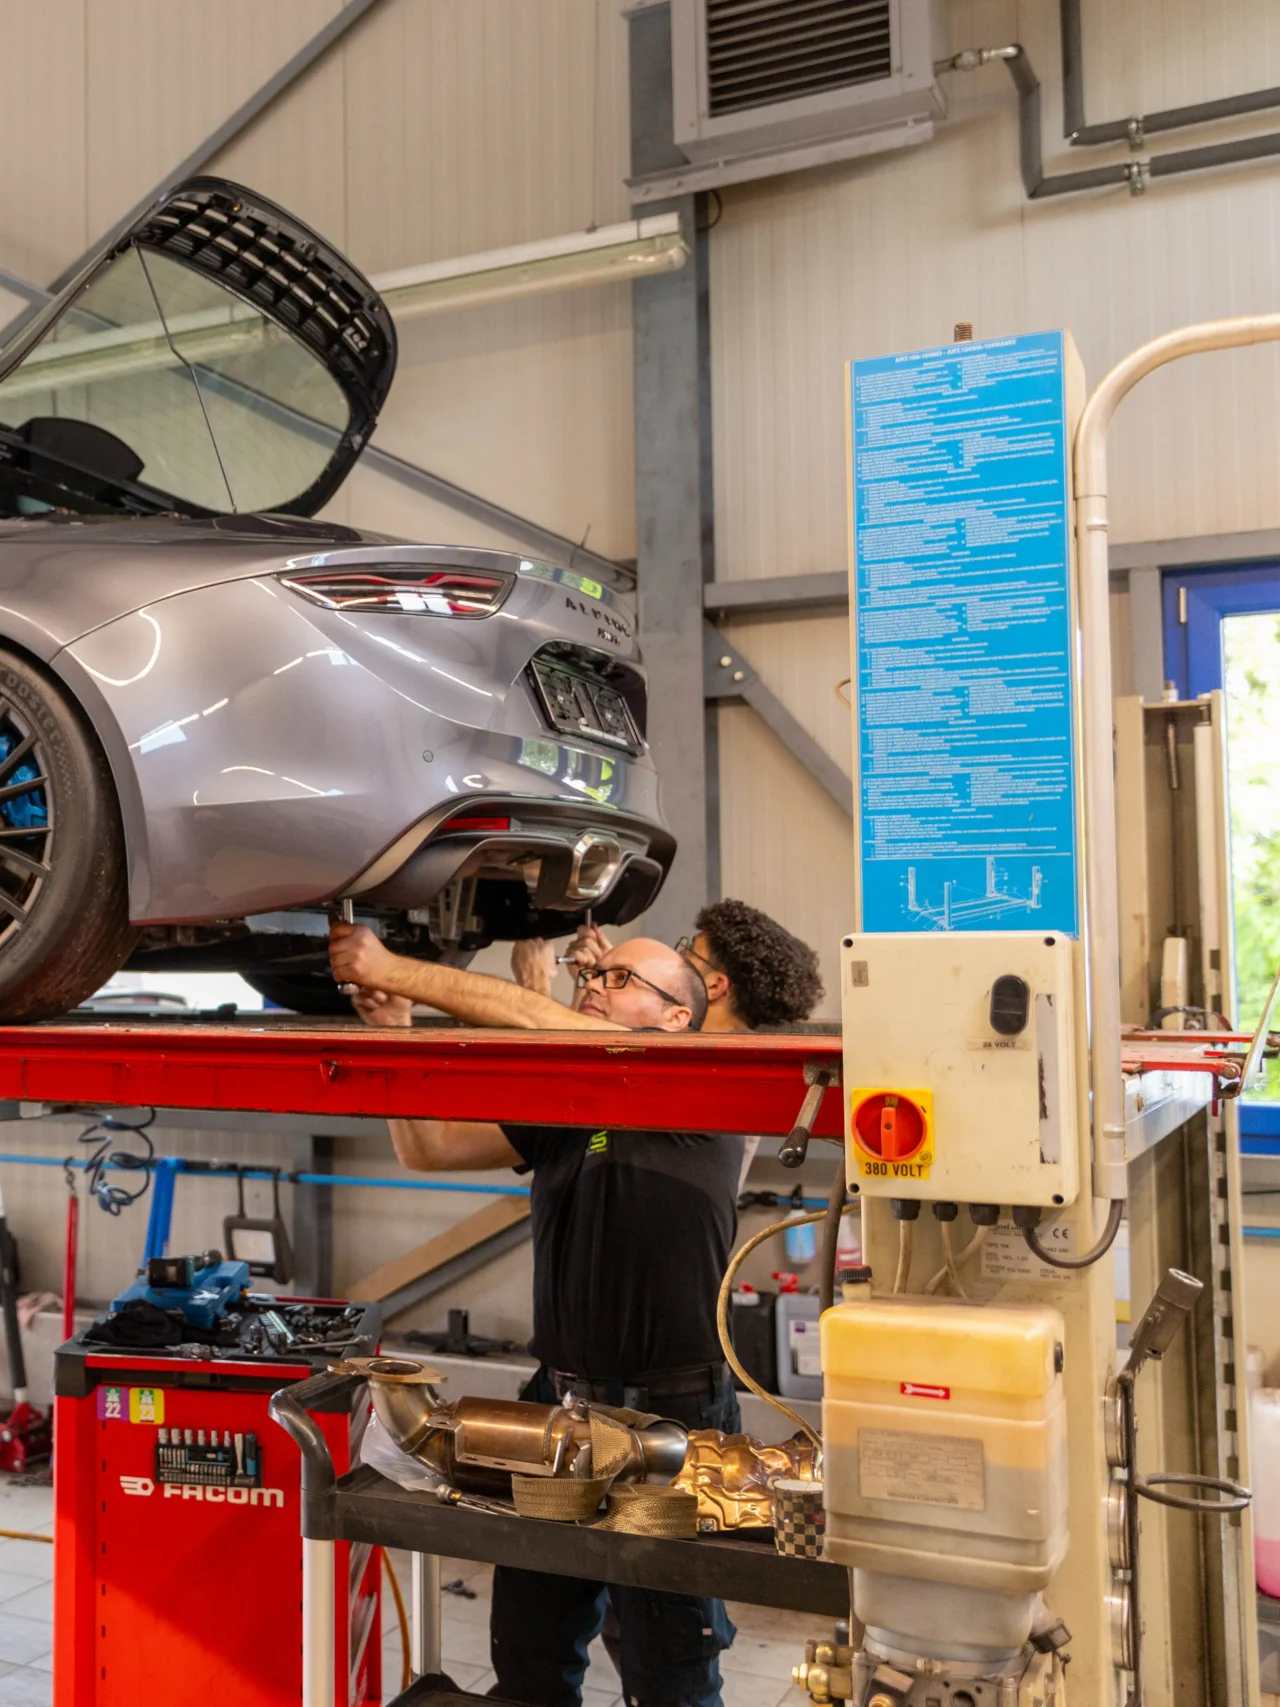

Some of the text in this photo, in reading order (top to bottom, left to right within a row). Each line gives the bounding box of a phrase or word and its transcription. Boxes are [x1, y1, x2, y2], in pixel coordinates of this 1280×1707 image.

[994, 1041, 1017, 1049] VOLT
[865, 1162, 924, 1177] 380 VOLT
[1052, 1227, 1069, 1240] CE
[104, 1402, 122, 1419] 22
[140, 1404, 155, 1421] 23
[163, 1483, 285, 1508] FACOM
